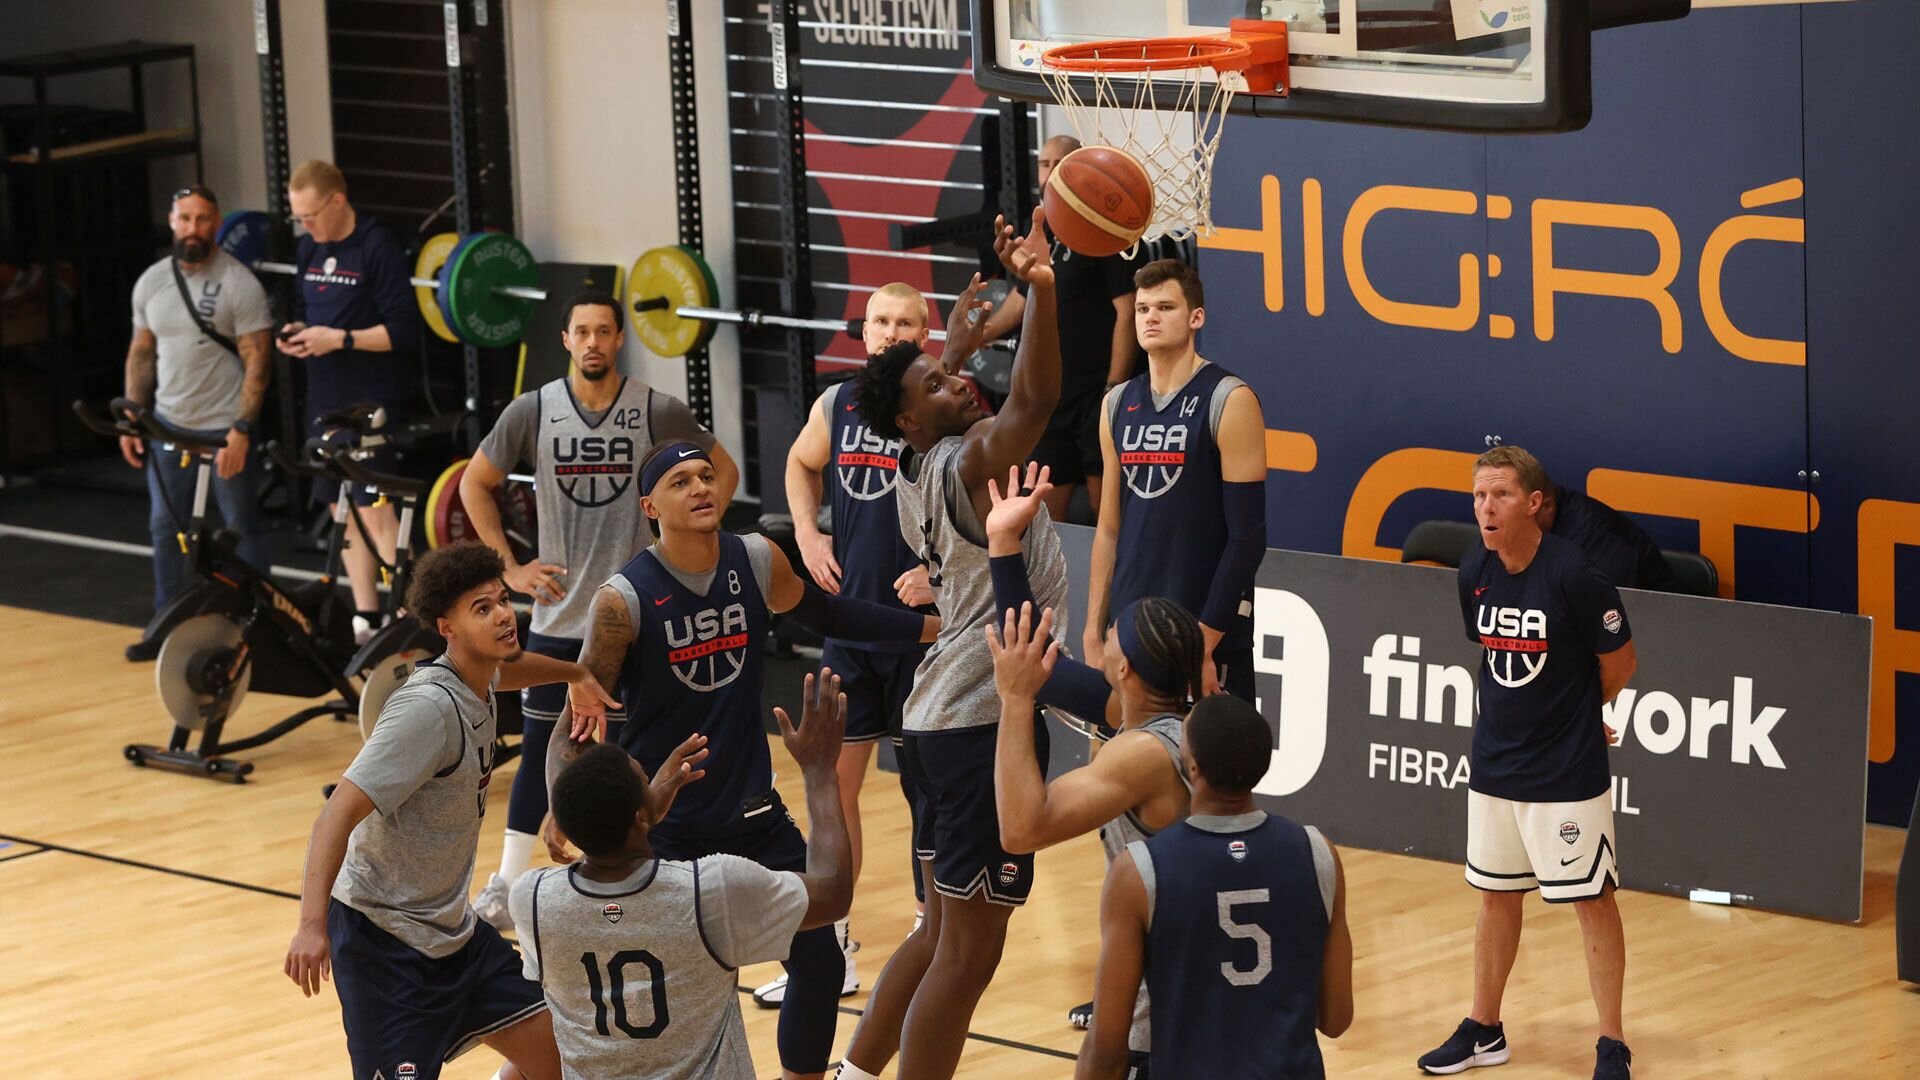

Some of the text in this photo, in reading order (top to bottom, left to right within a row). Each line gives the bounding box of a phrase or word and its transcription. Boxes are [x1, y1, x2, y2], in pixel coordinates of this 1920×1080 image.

[774, 26, 785, 87] RUSTER
[473, 241, 528, 269] RUSTER
[614, 408, 641, 430] 42
[1179, 395, 1199, 418] 14
[553, 437, 633, 463] USA
[1122, 424, 1188, 451] USA
[727, 569, 741, 595] 8
[664, 602, 747, 649] USA
[1477, 604, 1547, 639] USA
[674, 637, 744, 660] BASKETBALL
[1216, 888, 1273, 986] 5
[580, 949, 670, 1039] 10
